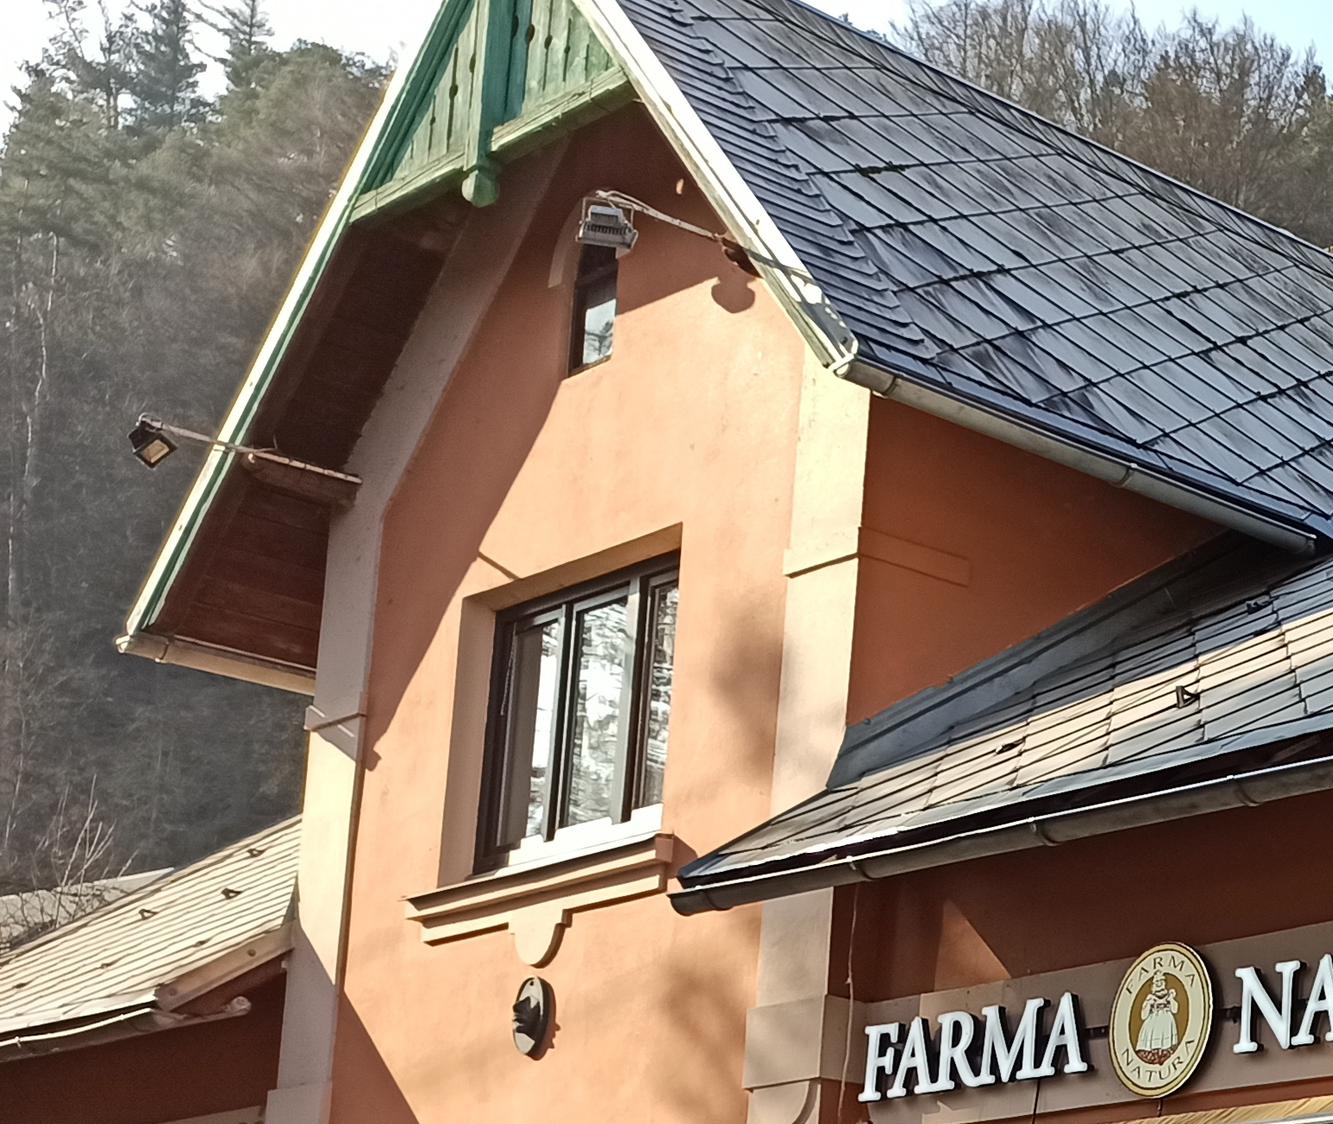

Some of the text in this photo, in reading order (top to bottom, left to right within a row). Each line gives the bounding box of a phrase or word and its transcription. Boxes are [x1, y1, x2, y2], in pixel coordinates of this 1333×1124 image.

[1126, 955, 1196, 995] FARMA
[857, 992, 1089, 1102] FARMA
[1122, 1039, 1196, 1083] NATURA
